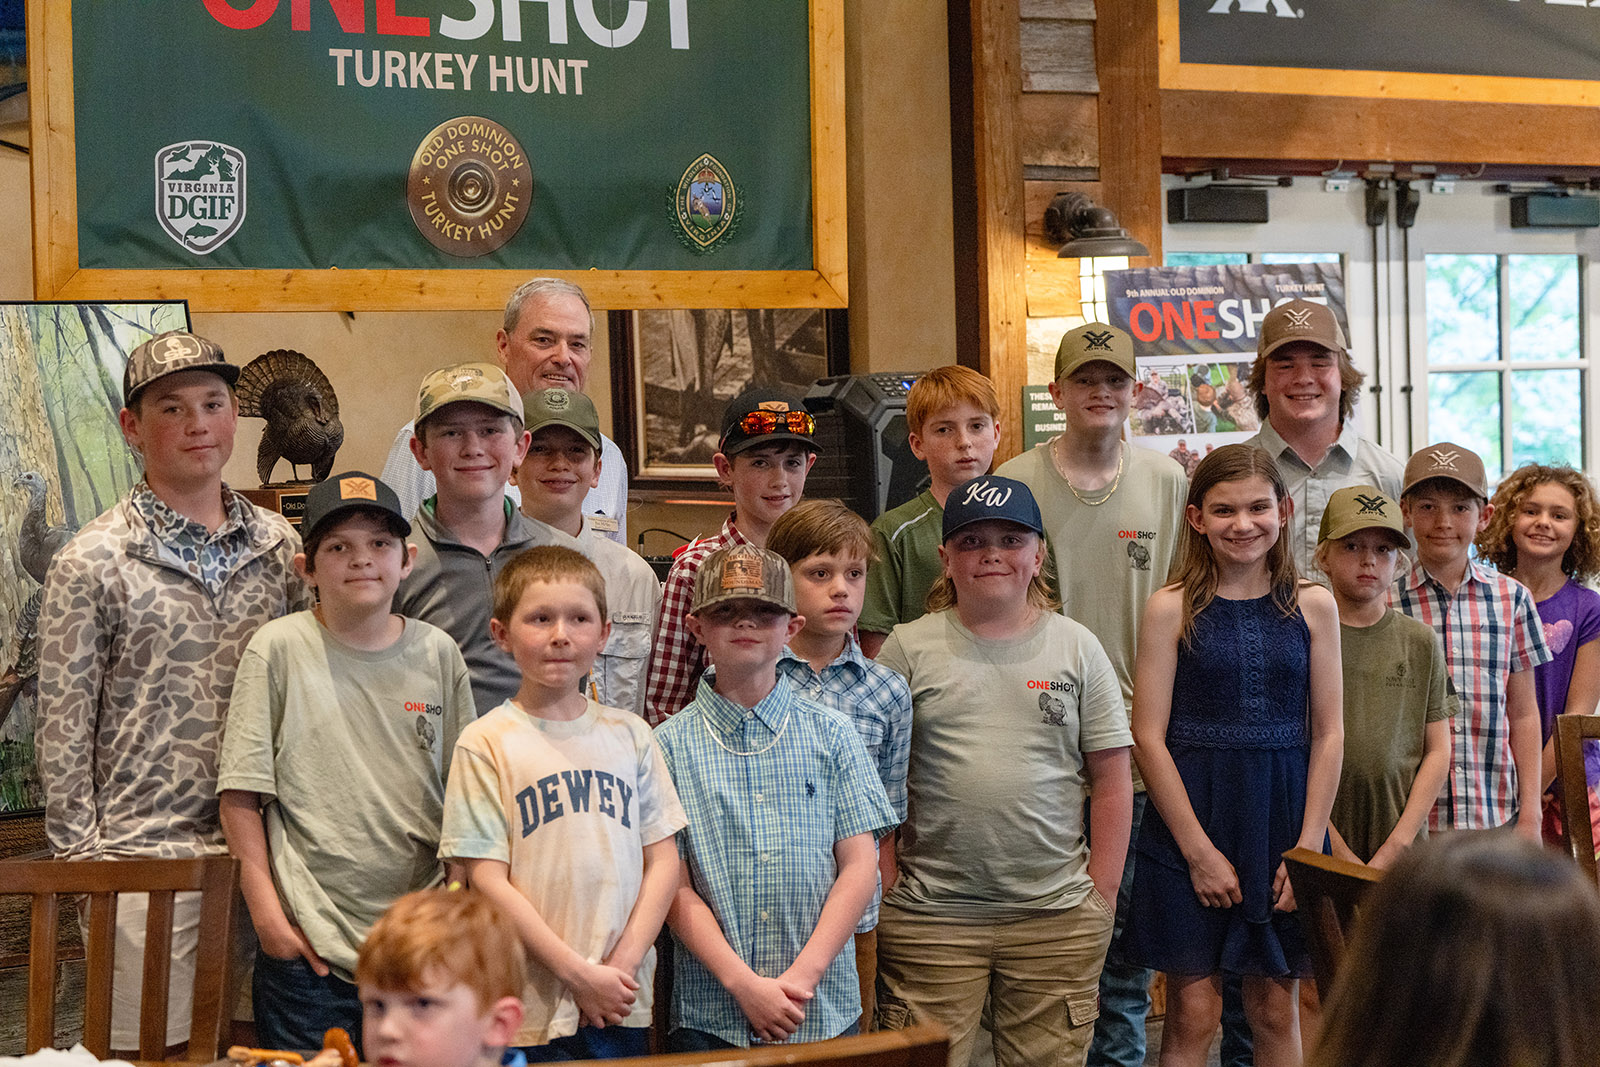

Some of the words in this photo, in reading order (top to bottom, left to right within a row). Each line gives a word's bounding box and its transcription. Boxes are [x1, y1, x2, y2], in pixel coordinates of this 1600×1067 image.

[329, 48, 478, 91] TURKEY
[489, 55, 588, 95] HUNT
[421, 136, 444, 166] OLD
[447, 123, 523, 169] DOMINION
[436, 140, 465, 169] ONE
[472, 139, 509, 171] SHOT
[168, 183, 234, 193] VIRGINIA
[682, 162, 704, 189] WILDLIFE
[709, 162, 732, 199] FOUNDATION
[168, 195, 235, 220] DGIF
[421, 191, 474, 241] TURKEY
[478, 192, 519, 239] HUNT
[686, 220, 726, 240] VIRGINIA
[1126, 289, 1139, 298] 9th
[1140, 288, 1170, 297] ANNUAL
[1170, 287, 1186, 296] OLD
[1187, 286, 1225, 295] DOMINION
[1275, 284, 1303, 293] TURKEY
[1304, 283, 1325, 292] HUNT
[1130, 297, 1327, 342] ONESH
[962, 480, 1012, 507] KW
[1027, 679, 1075, 694] ONESHOT
[515, 769, 633, 838] DEWEY
